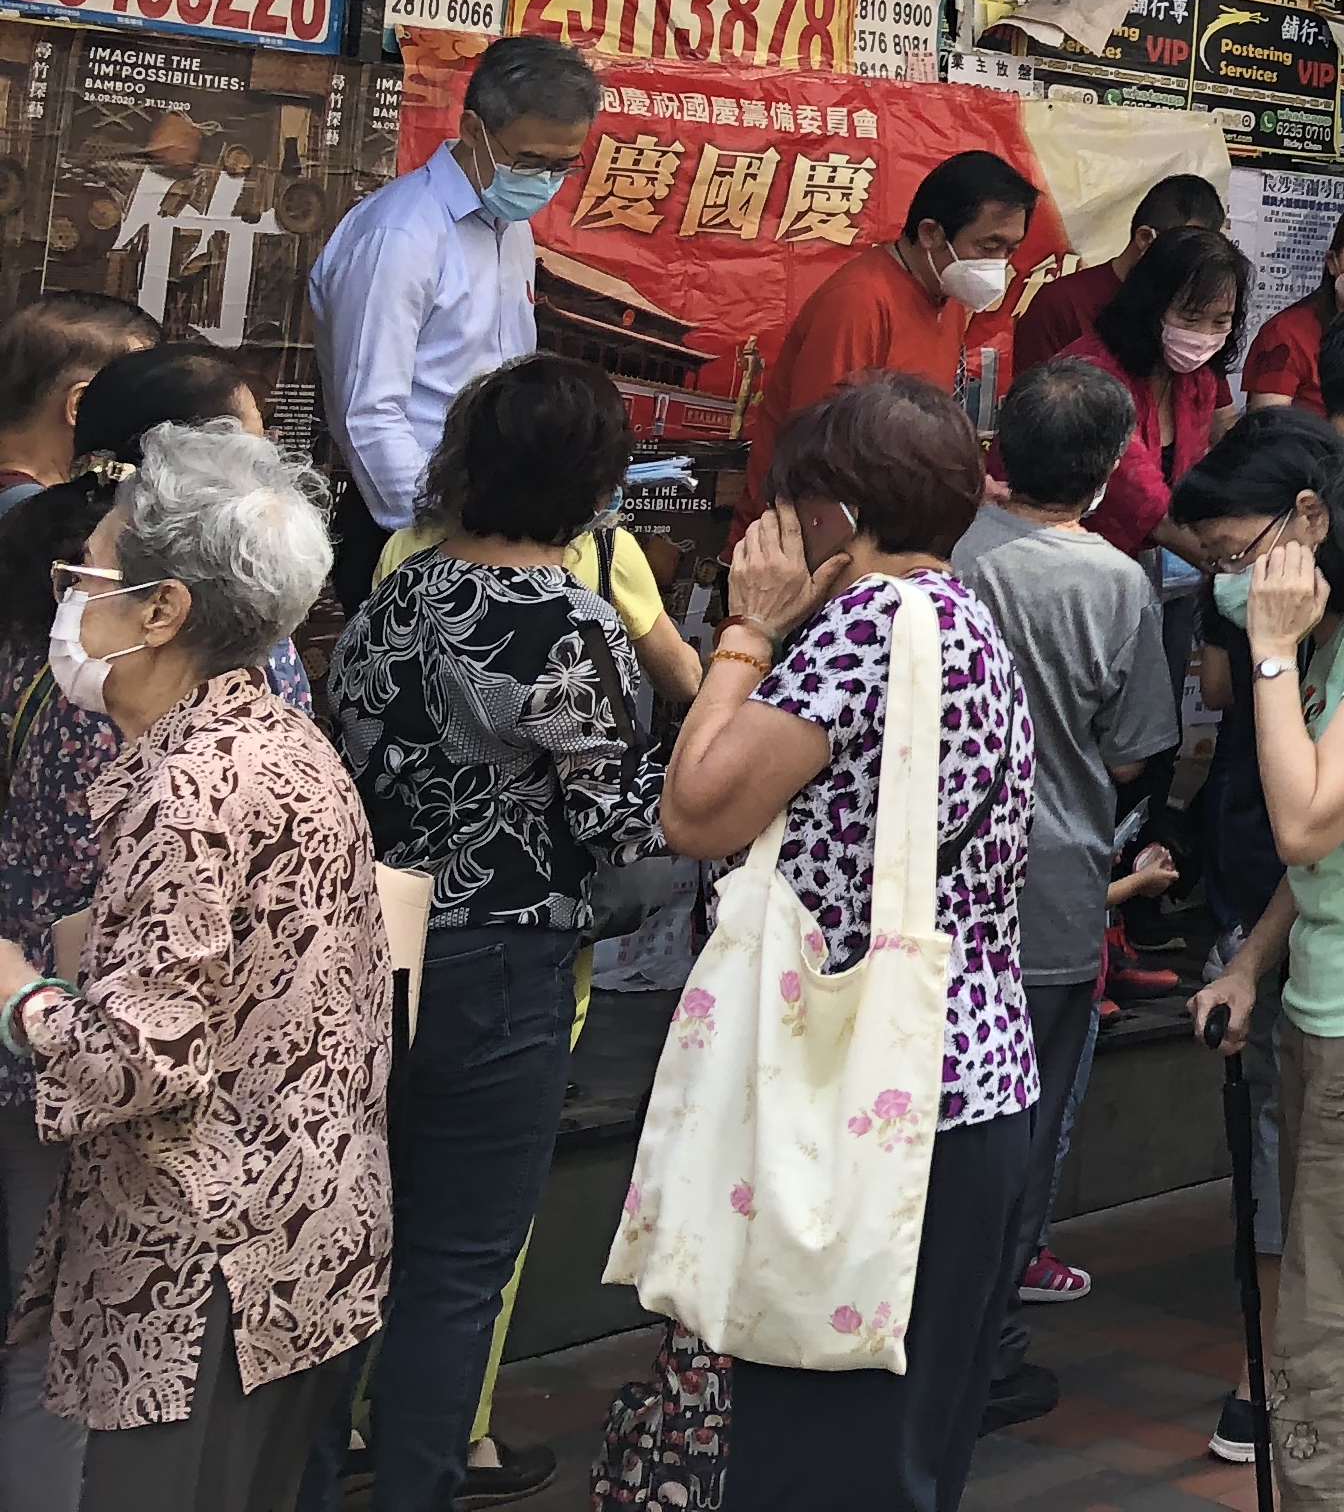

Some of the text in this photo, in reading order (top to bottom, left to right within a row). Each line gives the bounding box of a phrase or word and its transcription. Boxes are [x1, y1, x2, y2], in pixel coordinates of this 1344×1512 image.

[89, 46, 201, 71] IMAGINE THE
[1146, 35, 1190, 66] VIP
[1220, 38, 1293, 66] Postering
[84, 78, 146, 94] BAMBOO
[88, 63, 246, 91] 'IM'POSSIBILITIES:
[1219, 59, 1336, 88] Services VIP
[1276, 122, 1331, 141] 6235 0710
[570, 132, 878, 248] 慶國慶
